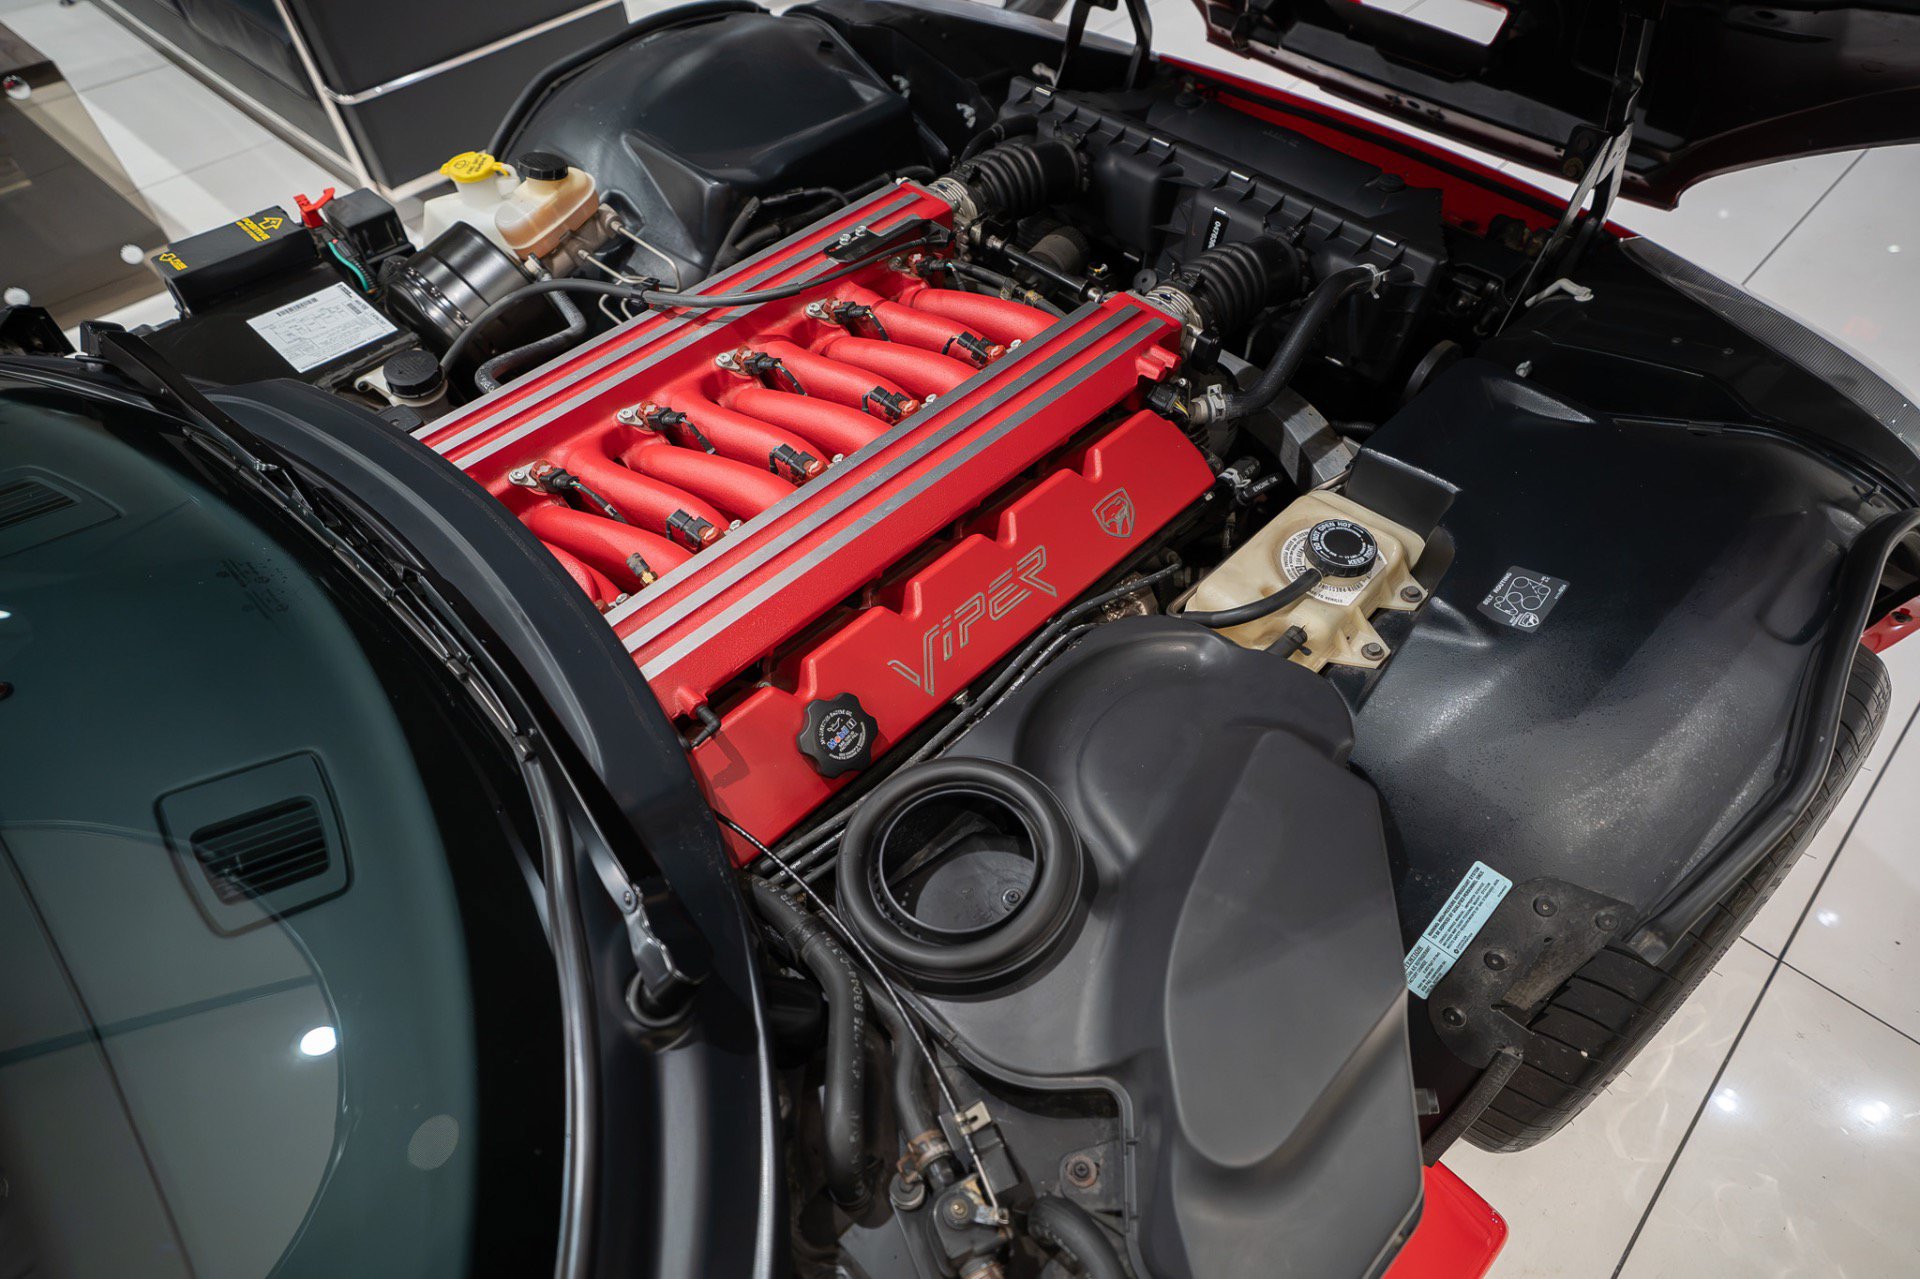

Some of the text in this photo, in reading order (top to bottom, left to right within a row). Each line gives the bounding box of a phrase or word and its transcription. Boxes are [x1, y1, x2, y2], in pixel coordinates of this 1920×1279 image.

[1312, 521, 1352, 551] DO NOT OPEN HOT
[1348, 544, 1374, 565] KEEP TIGHT
[1482, 572, 1512, 606] BELT ROUTING
